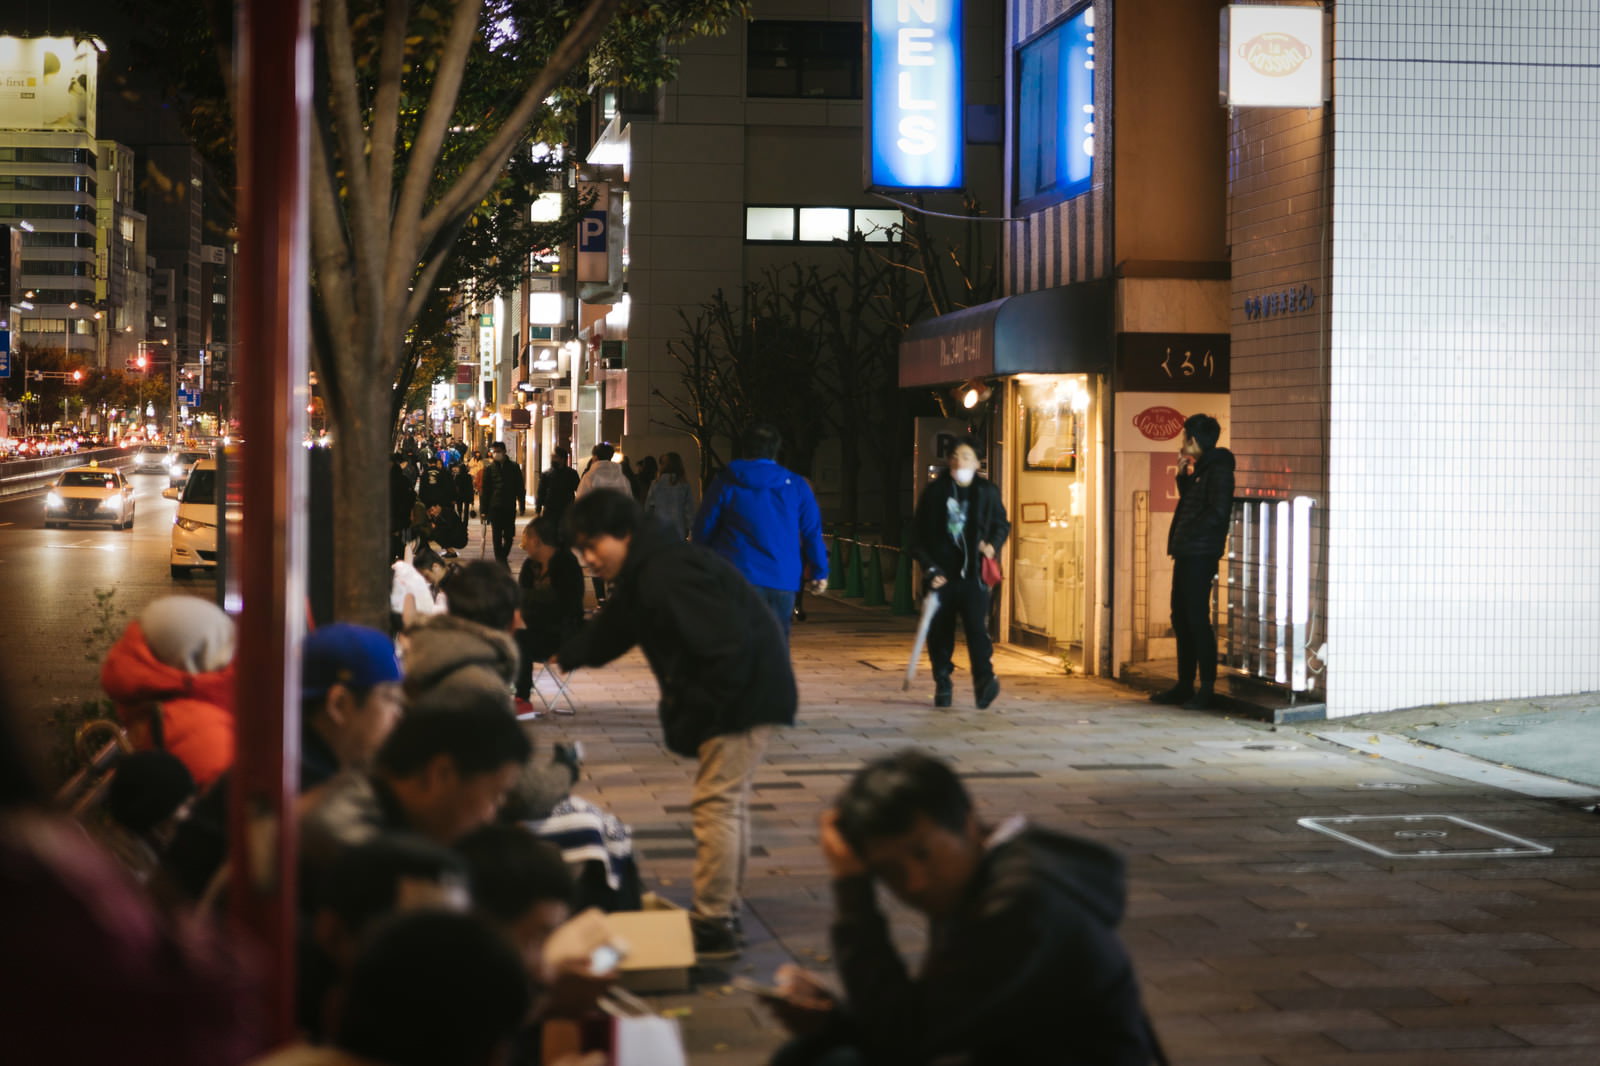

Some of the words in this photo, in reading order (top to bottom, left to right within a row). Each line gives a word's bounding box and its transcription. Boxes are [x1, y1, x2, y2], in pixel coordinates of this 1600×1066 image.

[582, 218, 603, 246] P
[1161, 347, 1214, 379] くるり
